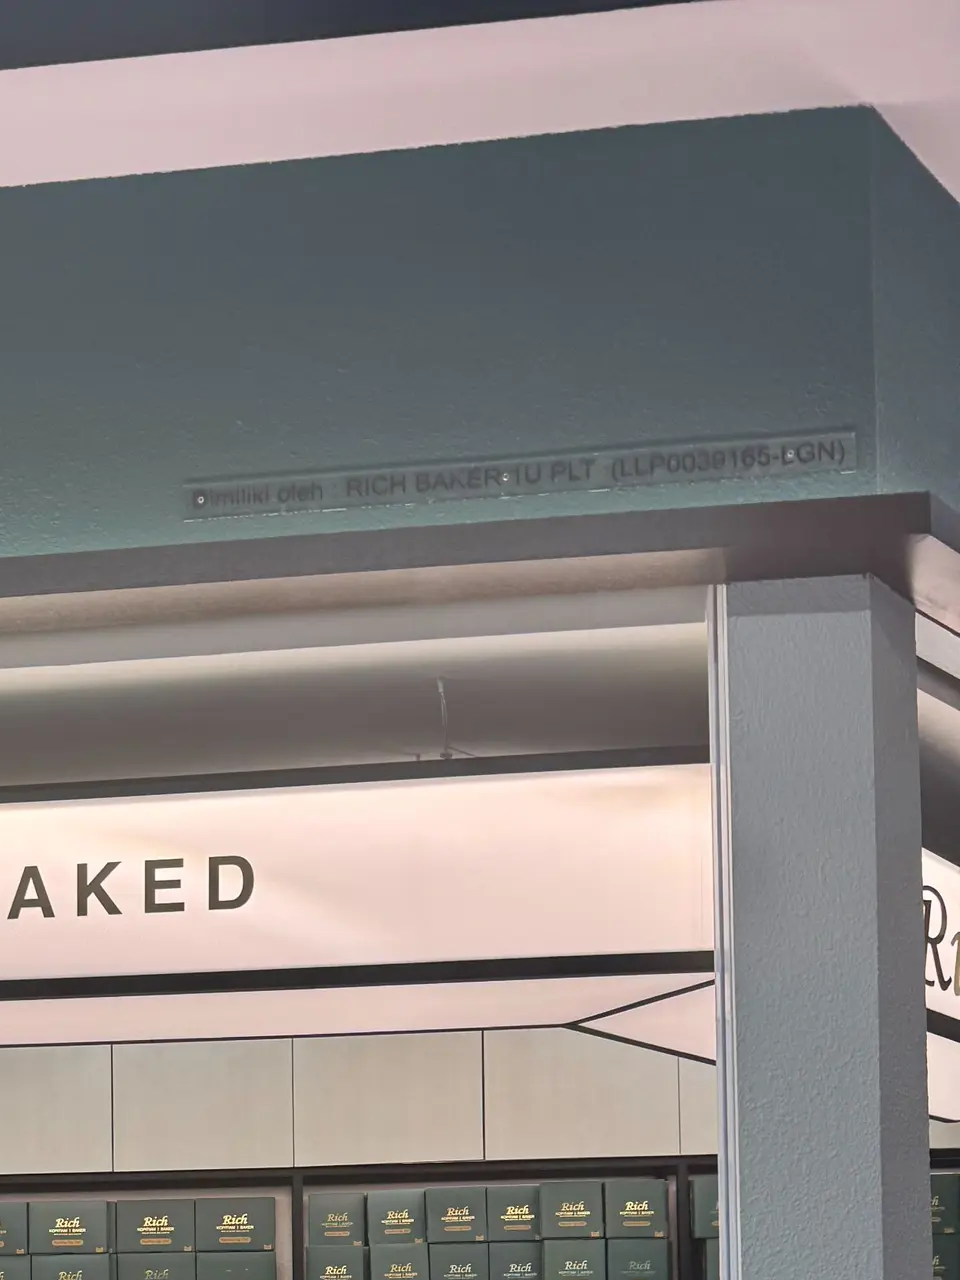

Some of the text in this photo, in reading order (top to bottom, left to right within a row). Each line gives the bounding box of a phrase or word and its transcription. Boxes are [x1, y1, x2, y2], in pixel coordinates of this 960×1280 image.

[346, 474, 406, 497] RICH
[415, 466, 501, 493] BAKER
[550, 457, 596, 482] PLT
[447, 1206, 469, 1216] Rich
[506, 1205, 530, 1215] Rich
[561, 1201, 585, 1211] Rich
[625, 1201, 649, 1211] Rich
[222, 1213, 248, 1225] Rich
[327, 1212, 349, 1222] Rich
[387, 1209, 409, 1219] Rich
[55, 1217, 80, 1228] Rich
[143, 1215, 168, 1226] Rich
[325, 1265, 347, 1275] Rich
[390, 1263, 412, 1272] Rich
[449, 1263, 472, 1273] Rich
[509, 1263, 532, 1273] Rich
[565, 1260, 588, 1270] Rich
